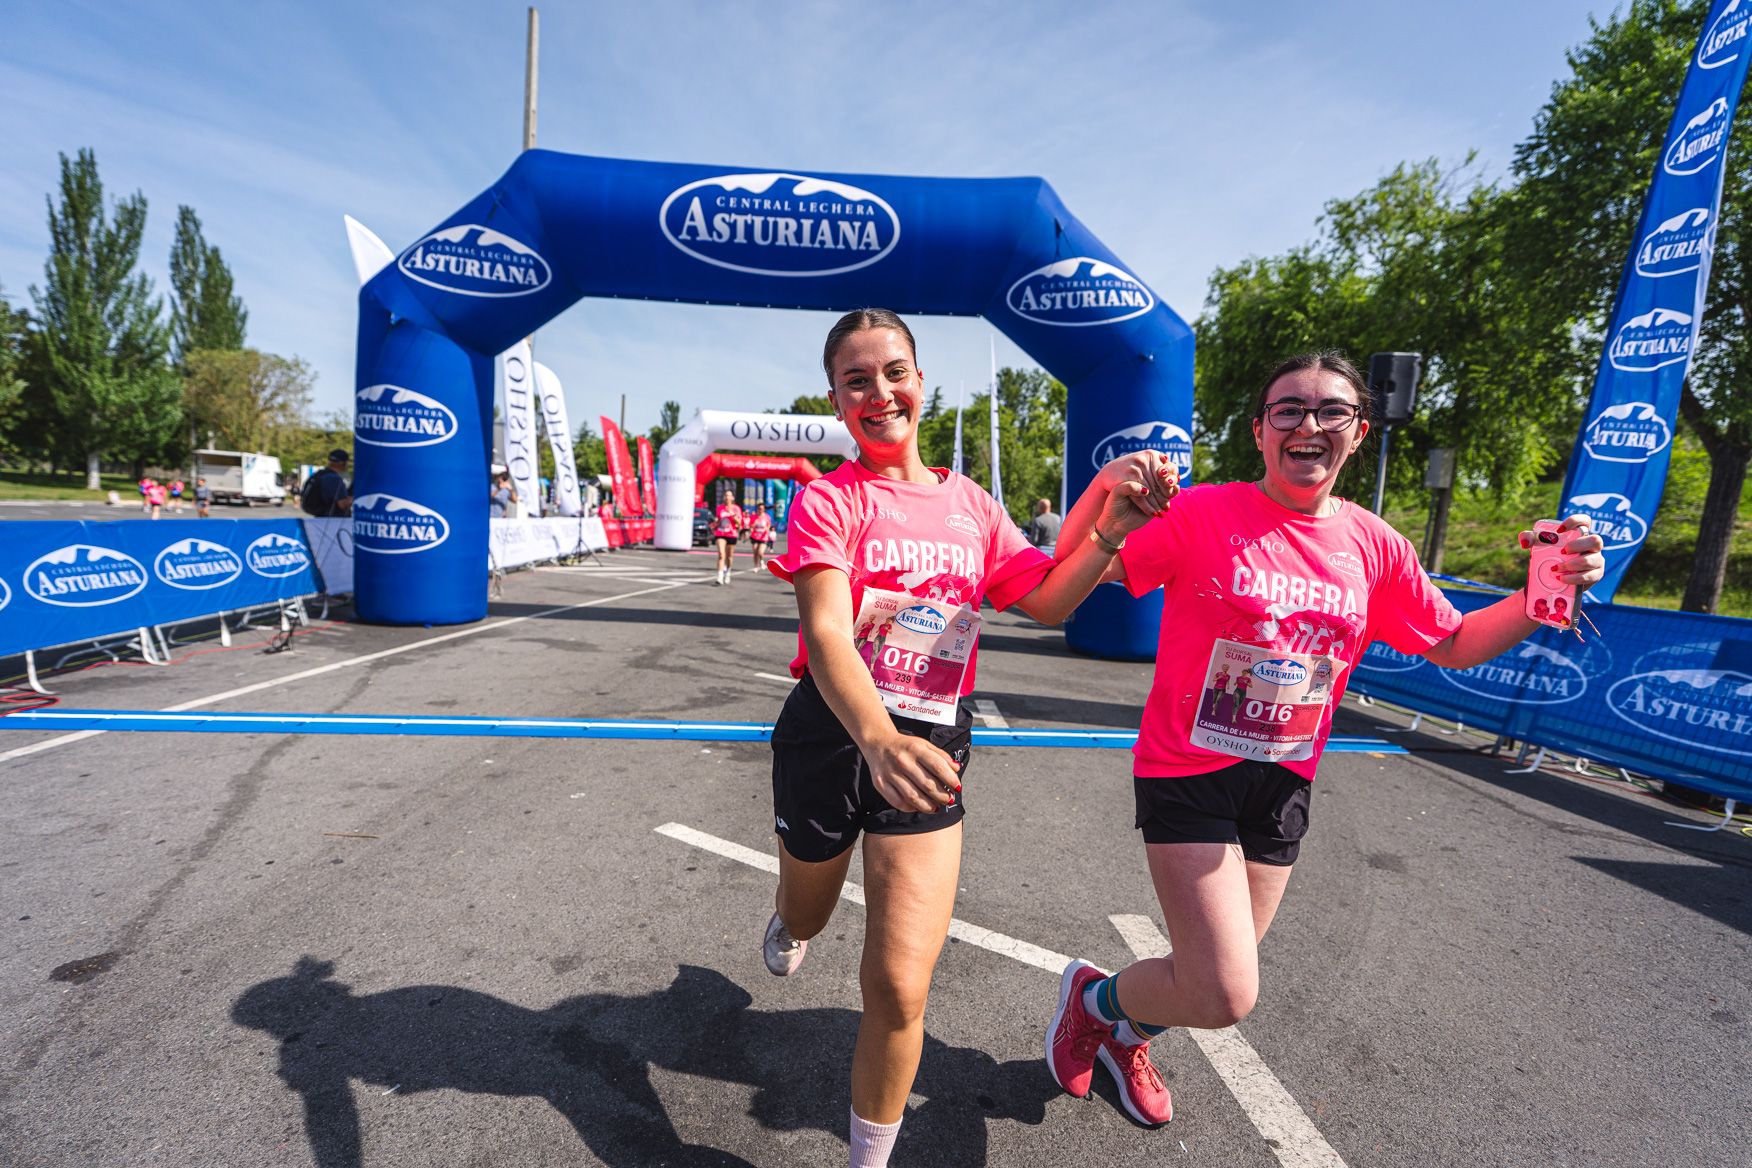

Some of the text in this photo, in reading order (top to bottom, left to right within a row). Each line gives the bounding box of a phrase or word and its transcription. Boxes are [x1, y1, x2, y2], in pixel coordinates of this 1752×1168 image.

[716, 196, 875, 216] CENTRAL LECHERA
[678, 196, 881, 251] ASTURIANA
[405, 245, 539, 286] ASTURIANA
[1041, 280, 1091, 290] CENTRAL
[1018, 285, 1148, 311] ASTURIANA
[356, 412, 447, 436] STURIANA
[731, 419, 825, 443] OYSHO
[354, 521, 438, 542] STURIANA
[1230, 534, 1285, 554] OYSHO
[163, 558, 238, 580] ASTURIANA
[865, 538, 977, 579] CARRERA
[38, 570, 142, 597] ASTURIANA
[1232, 565, 1357, 621] CARRERA
[874, 601, 897, 612] SUMA
[898, 611, 943, 631] ASTURIANA
[883, 647, 930, 675] 016
[1224, 651, 1252, 664] SUMA
[895, 672, 912, 684] 239
[1256, 664, 1304, 681] ASTURIANA
[1446, 664, 1569, 697] STURIANA
[884, 682, 905, 693] MUJER
[907, 703, 942, 717] Santander
[1245, 700, 1294, 722] 016
[1619, 681, 1752, 736] ASTURI
[1199, 719, 1229, 733] CARRERA
[1230, 727, 1239, 736] DE
[1239, 729, 1248, 737] LA
[1248, 731, 1270, 741] MUJER
[1259, 722, 1276, 733] 238
[1206, 735, 1249, 752] OYSHO
